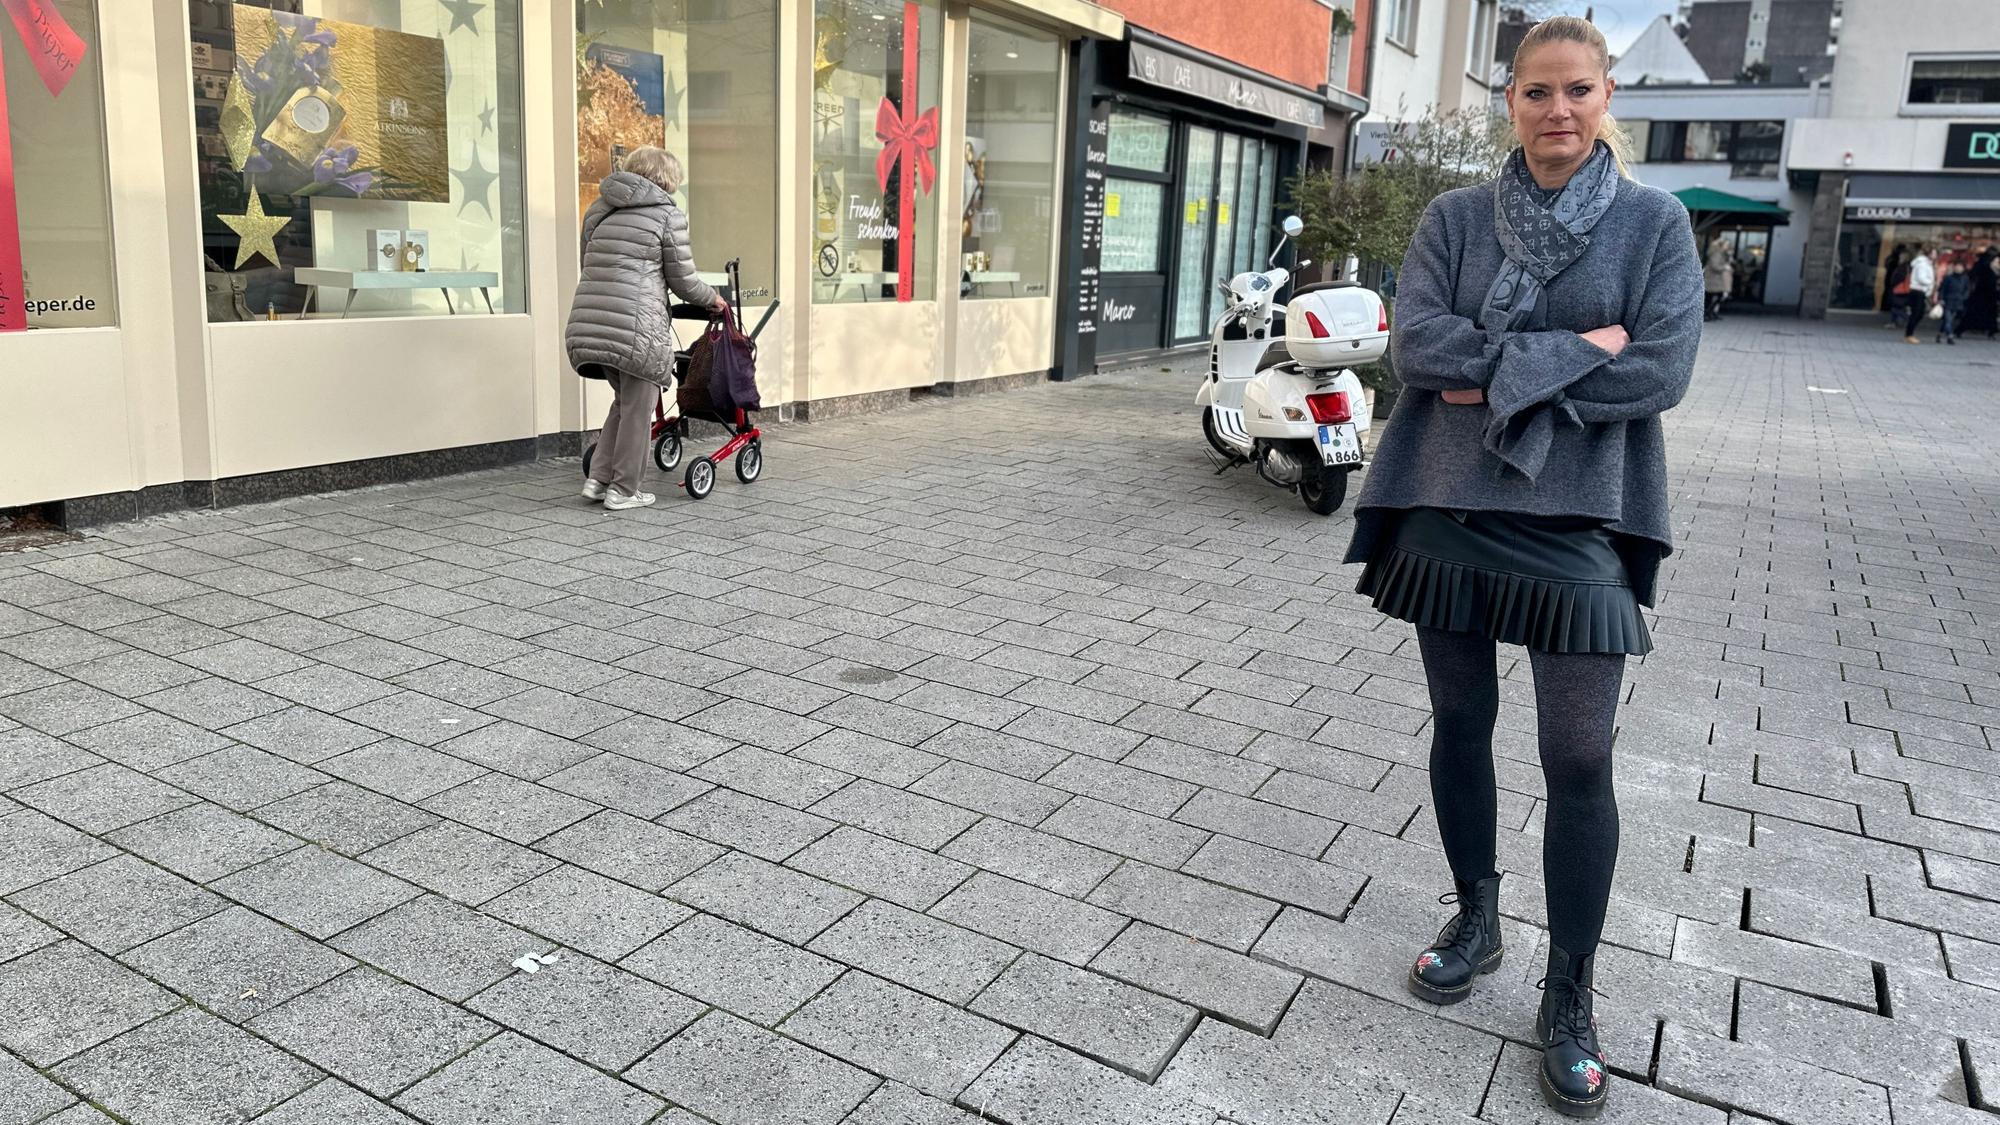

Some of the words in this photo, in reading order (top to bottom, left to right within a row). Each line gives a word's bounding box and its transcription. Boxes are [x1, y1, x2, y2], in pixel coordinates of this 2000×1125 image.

[373, 119, 427, 136] ATKINSONS
[849, 194, 882, 220] Freude
[1857, 207, 1912, 219] DOUGLAS
[857, 218, 900, 240] schenken
[1102, 298, 1137, 322] Marco
[1334, 425, 1343, 437] K
